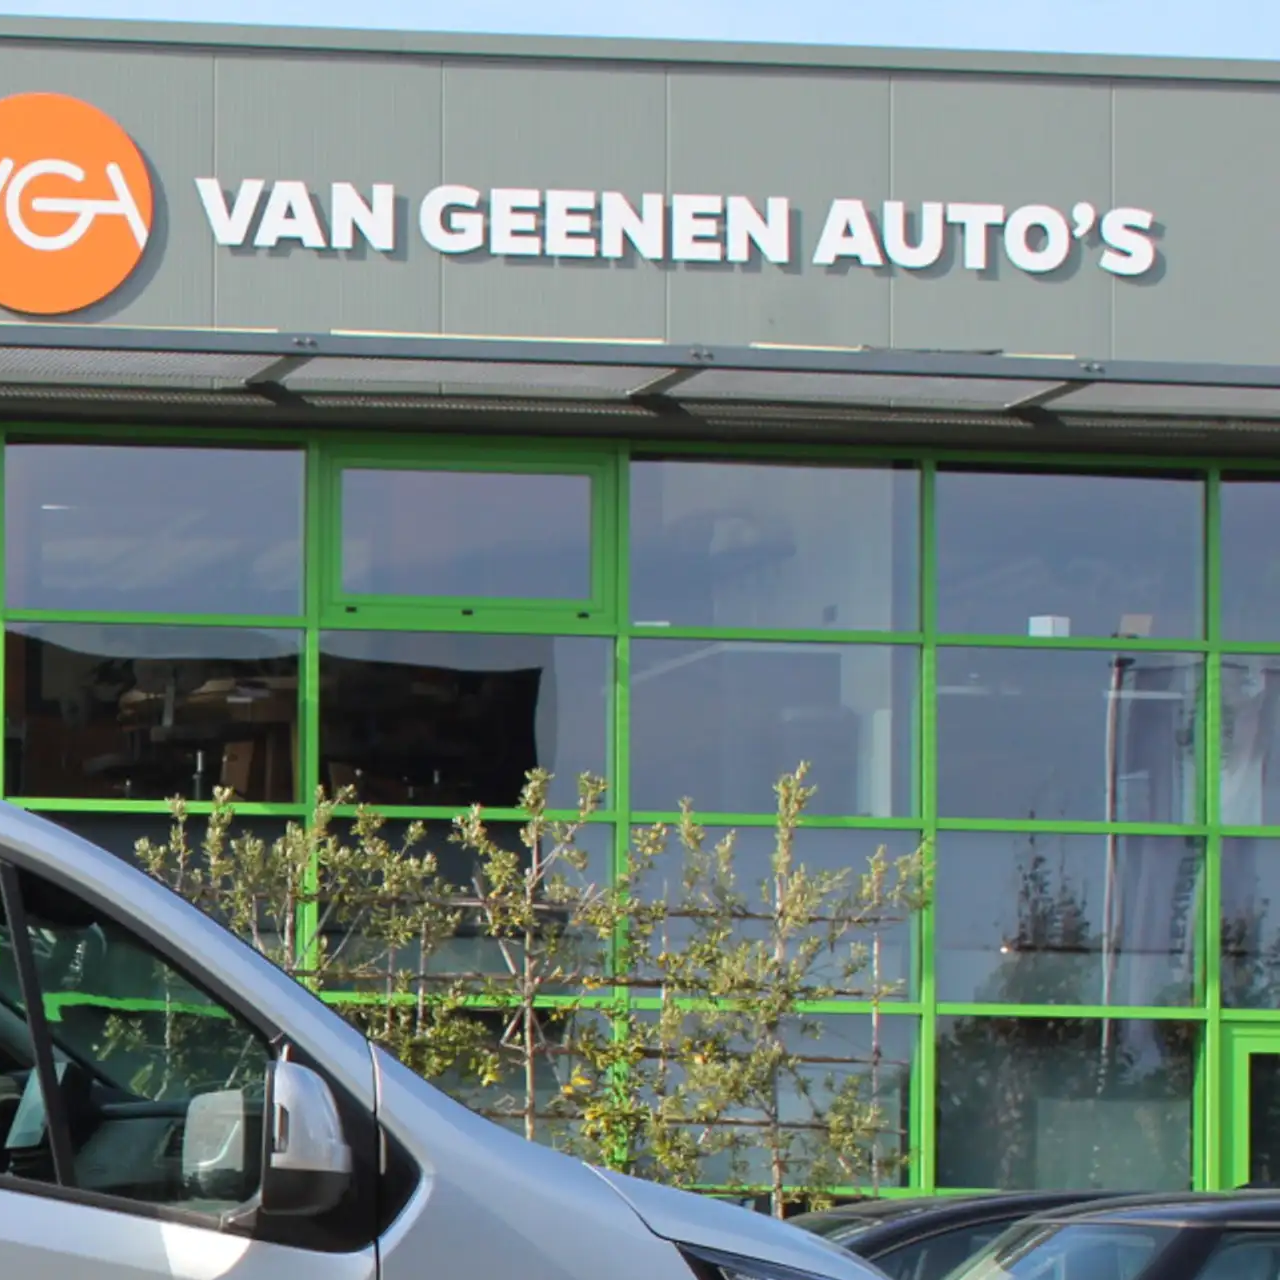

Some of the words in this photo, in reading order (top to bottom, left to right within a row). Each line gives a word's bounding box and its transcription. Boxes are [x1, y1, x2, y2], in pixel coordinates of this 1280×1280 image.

[194, 176, 394, 251] VAN
[418, 184, 790, 265] GEENEN
[811, 197, 1156, 277] AUTO'S
